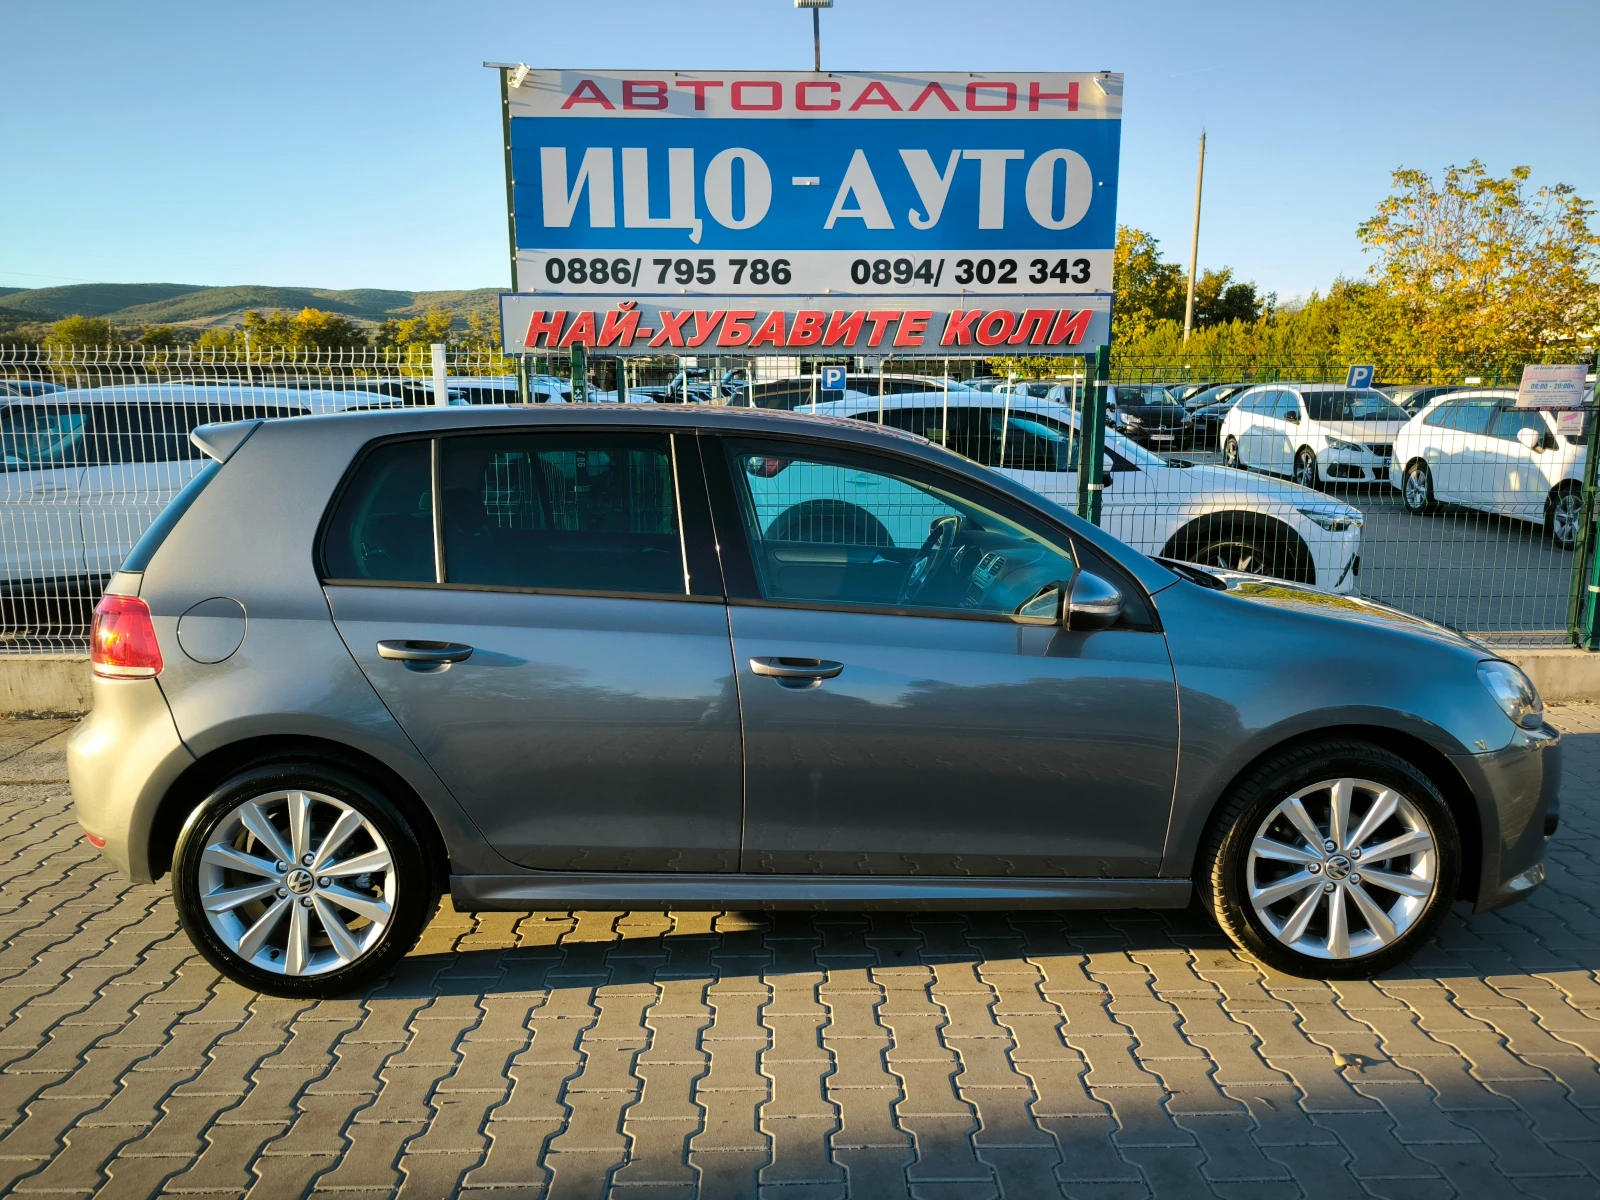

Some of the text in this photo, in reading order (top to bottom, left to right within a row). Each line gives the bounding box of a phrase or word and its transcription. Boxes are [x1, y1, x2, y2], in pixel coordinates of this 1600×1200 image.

[562, 80, 1080, 112] АВТОСАЛОН
[545, 257, 792, 288] 0886/ 795 786
[850, 257, 1092, 288] 0894/ 302 343
[523, 300, 1093, 347] НАЙ-ХУБАВИТЕ КОЛИ
[826, 369, 841, 388] P
[1351, 367, 1369, 387] P
